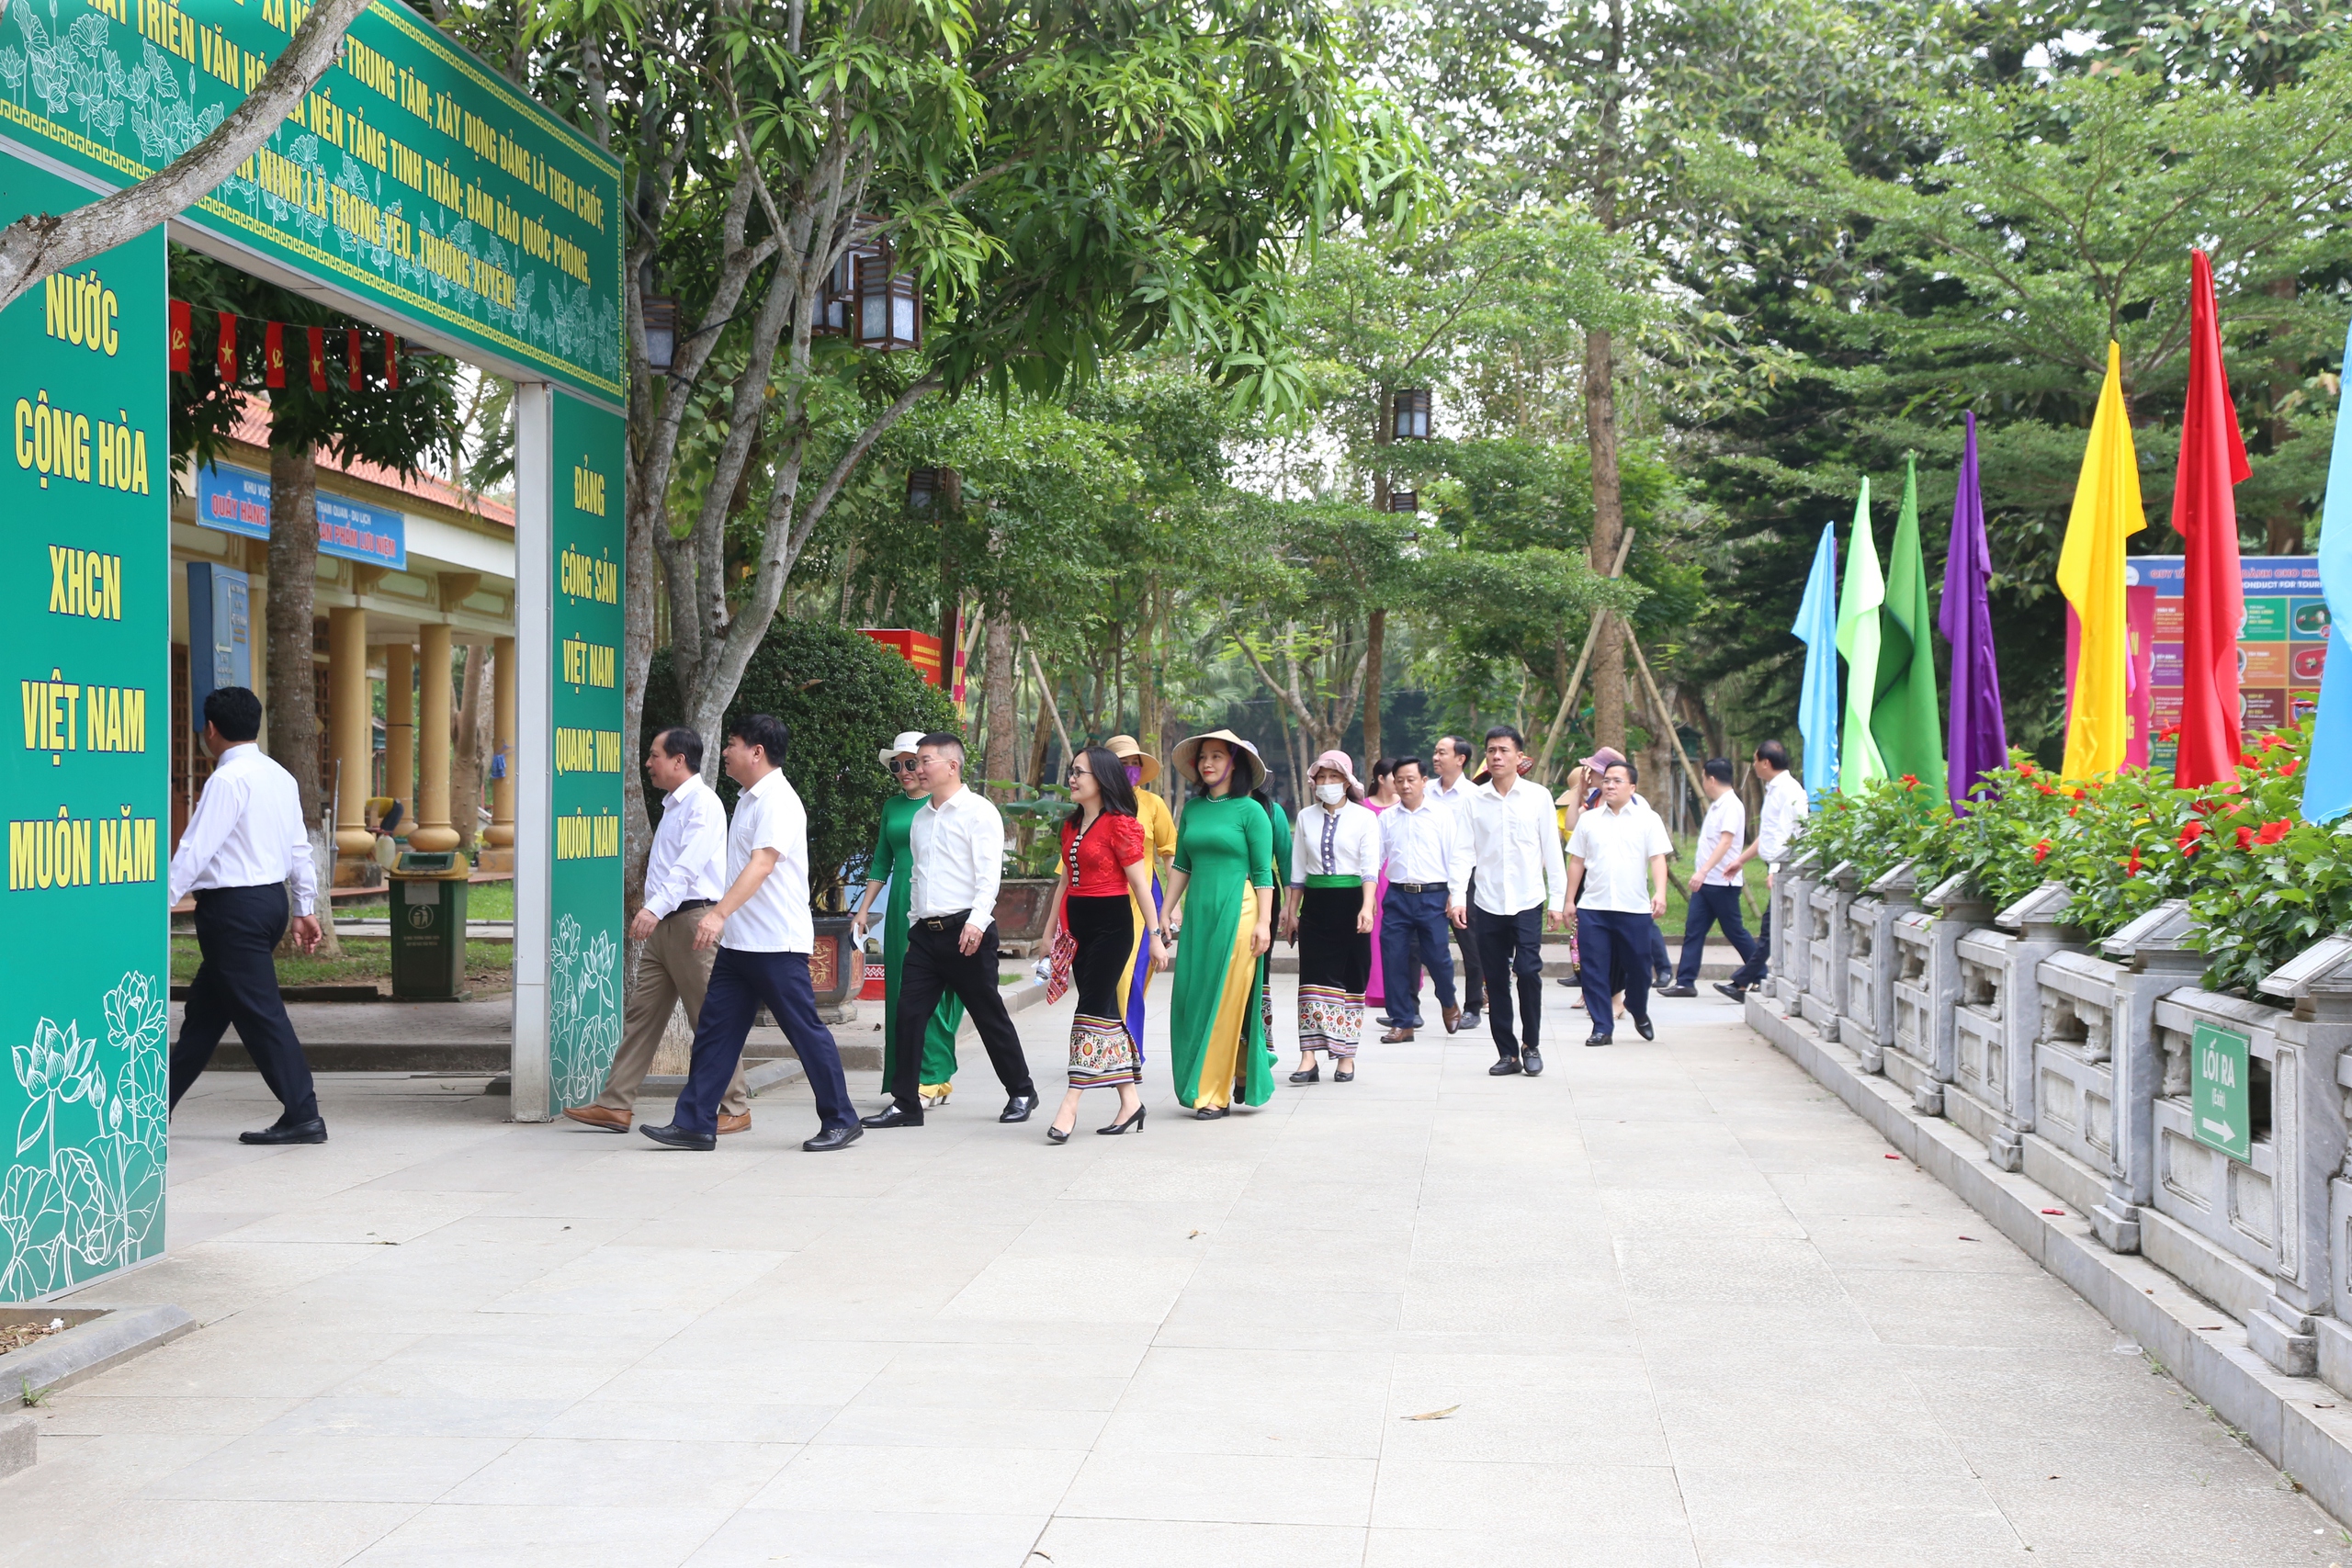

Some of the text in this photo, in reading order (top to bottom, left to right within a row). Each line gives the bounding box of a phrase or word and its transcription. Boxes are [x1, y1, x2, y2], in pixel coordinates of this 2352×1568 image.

[199, 22, 240, 90] VĂN
[243, 51, 269, 96] HÓ
[310, 85, 344, 150] NỀN
[347, 106, 387, 174] TẢNG
[390, 137, 423, 193] TINH
[425, 157, 464, 220] THẦN;
[466, 176, 494, 231] ĐẢM
[496, 194, 520, 246] BẢO
[522, 214, 551, 264] QUỐC
[553, 234, 592, 289] PHÒNG,
[345, 32, 396, 103] TRUNG
[399, 64, 433, 130] TÂM;
[435, 89, 461, 141] XÂY
[464, 108, 497, 165] DỰNG
[499, 128, 531, 186] ĐẢNG
[533, 152, 548, 196] LÀ
[548, 165, 575, 213] THEN
[577, 184, 605, 235] CHỐT;
[259, 144, 302, 208] NINH
[307, 165, 328, 220] LÀ
[331, 182, 381, 247] TRỌNG
[384, 205, 415, 261] YẾU,
[419, 228, 470, 290] THƯỜNG
[472, 255, 516, 312] XUYÊN!
[46, 268, 119, 357] NƯỚC
[14, 388, 150, 496] CỘNG HÒA
[243, 479, 257, 495] KHU
[316, 501, 333, 515] THAM
[333, 504, 349, 520] QUAN
[351, 509, 359, 523] DU
[359, 512, 372, 527] LỊCH
[574, 454, 605, 517] ĐẢNG
[240, 497, 267, 527] HÀNG
[376, 533, 397, 559] NIỆM
[49, 544, 121, 621] XHCN
[560, 541, 617, 606] CỘNG SẢN
[2241, 581, 2278, 589] ONDUCT
[2279, 581, 2296, 589] FOR
[2274, 569, 2301, 579] CHO
[562, 631, 615, 694] VIỆT NAM
[20, 667, 146, 767] VIỆT NAM
[555, 726, 621, 777] QUANG VINH
[8, 804, 157, 891] MUÔN NĂM
[557, 806, 618, 861] MUÔN NĂM
[2202, 1037, 2236, 1089] LỐI RA
[2211, 1087, 2226, 1111] (Exit)
